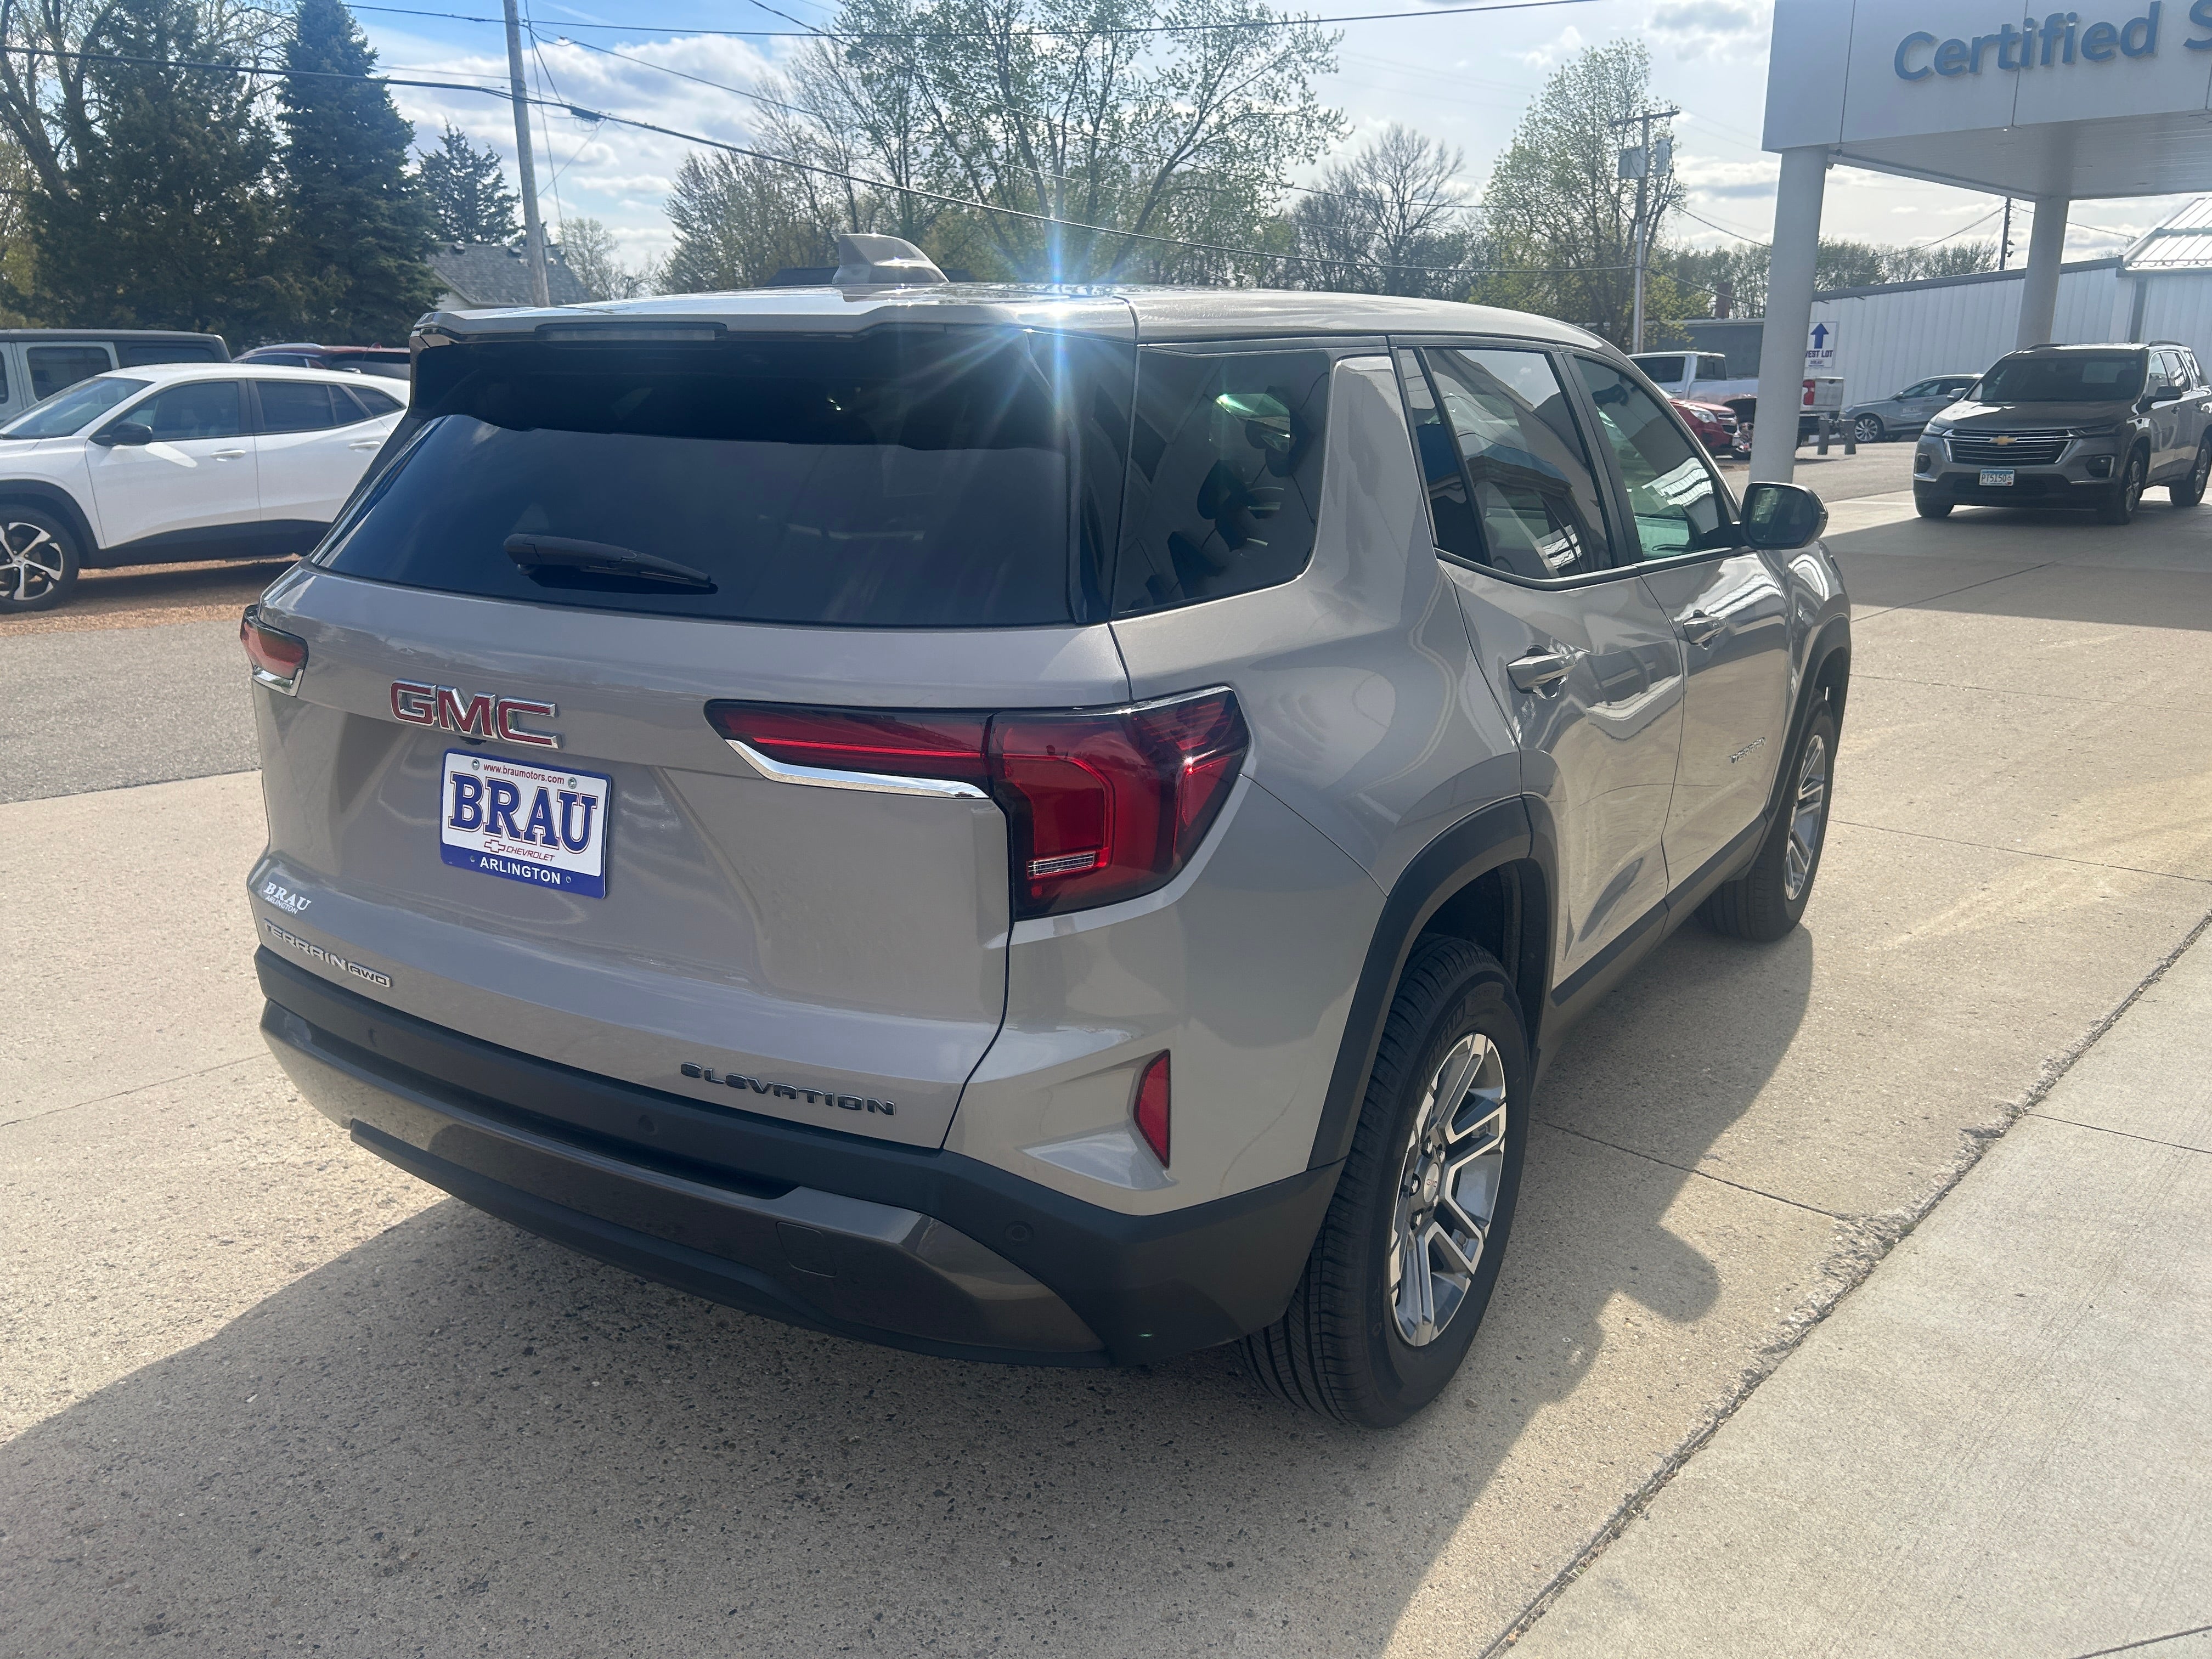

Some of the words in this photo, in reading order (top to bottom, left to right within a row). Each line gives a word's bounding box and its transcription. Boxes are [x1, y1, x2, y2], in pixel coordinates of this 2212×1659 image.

[1894, 1, 2162, 81] Certified
[1981, 474, 2007, 482] PT5150
[391, 678, 563, 749] GMC
[483, 763, 565, 785] www.braumotors.com
[448, 771, 599, 854] BRAU
[506, 845, 556, 862] CHEVROLET
[480, 856, 561, 885] ARLINGTON
[263, 882, 312, 911] BRAU
[265, 895, 298, 915] ARLINGTON
[263, 918, 348, 970] TERRAIN
[349, 964, 389, 986] AWD
[680, 1062, 896, 1116] ELEVATION
